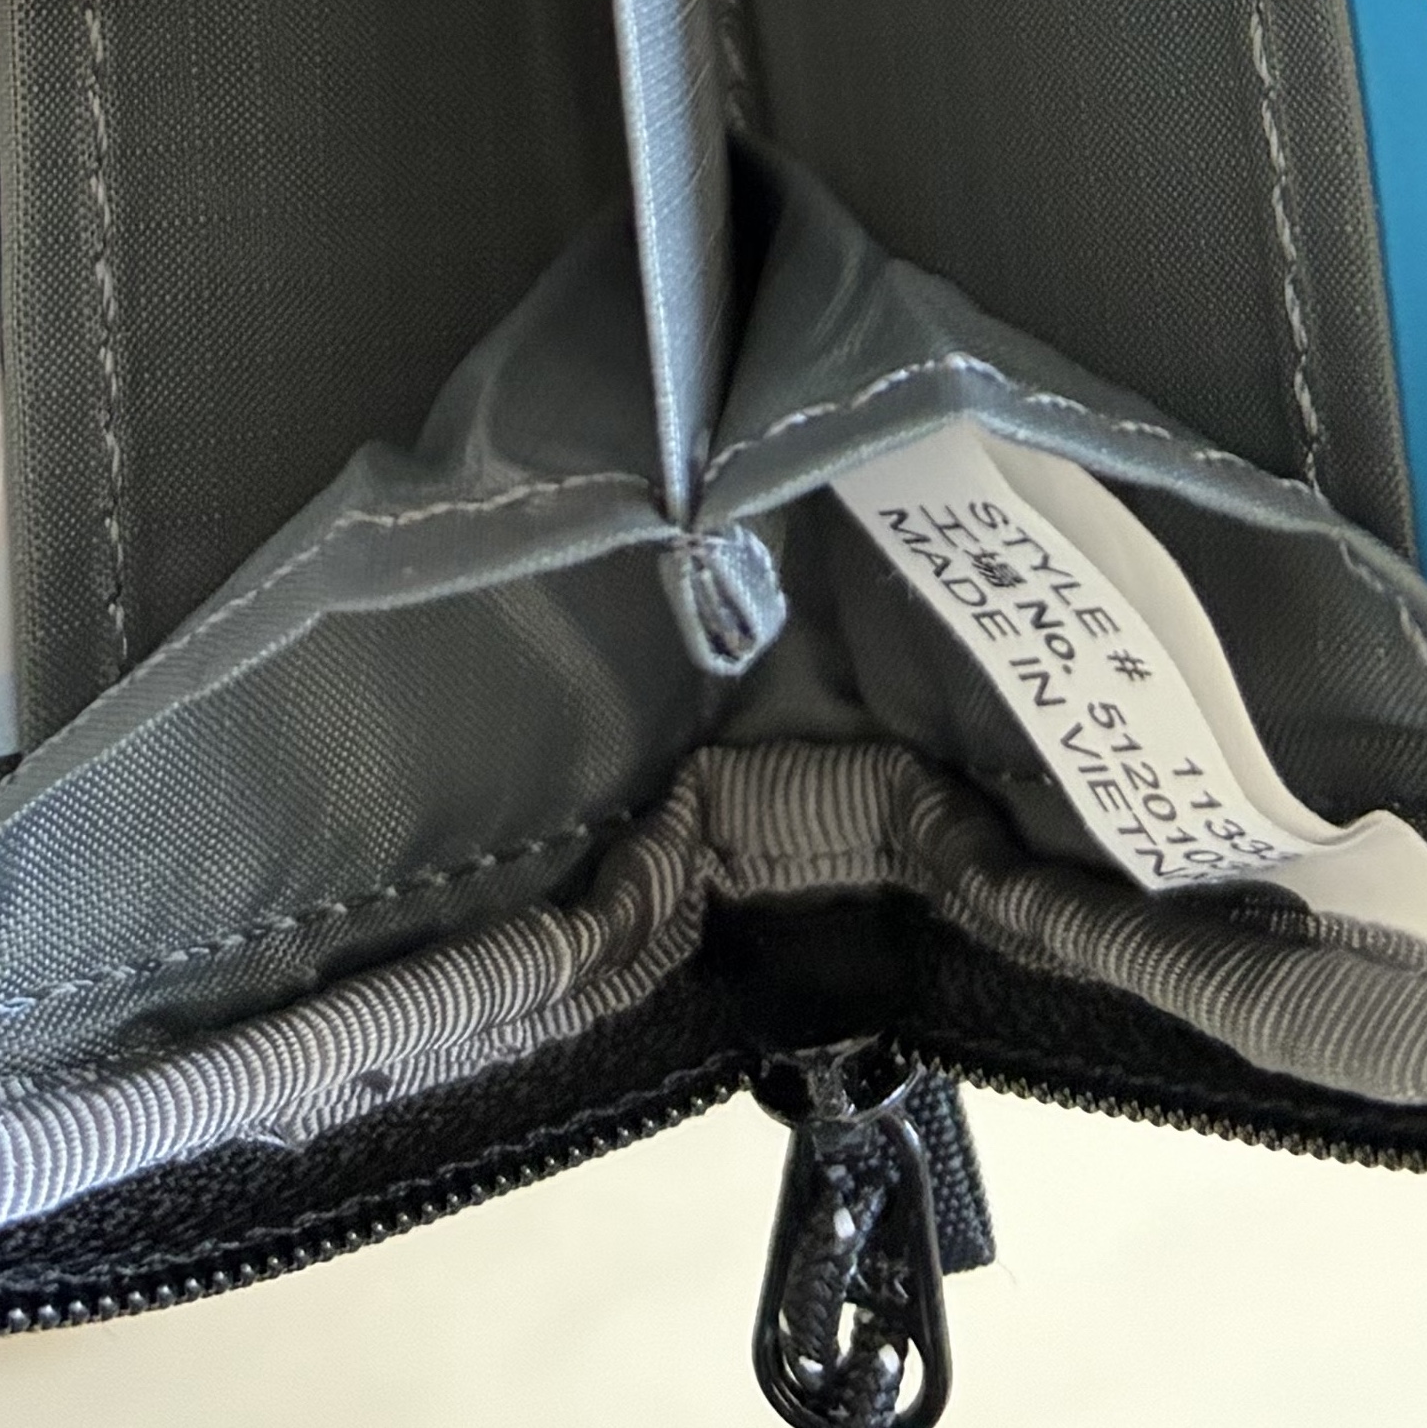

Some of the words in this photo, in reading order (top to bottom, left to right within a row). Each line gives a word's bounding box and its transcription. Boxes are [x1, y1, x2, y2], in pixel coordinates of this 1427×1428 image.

[879, 508, 1020, 641] MADE
[1009, 656, 1066, 707] IN
[1060, 722, 1212, 881] VIETN
[969, 501, 1120, 638] STYLE
[1107, 649, 1152, 682] #
[1014, 599, 1076, 674] No.
[1087, 701, 1262, 871] 512010
